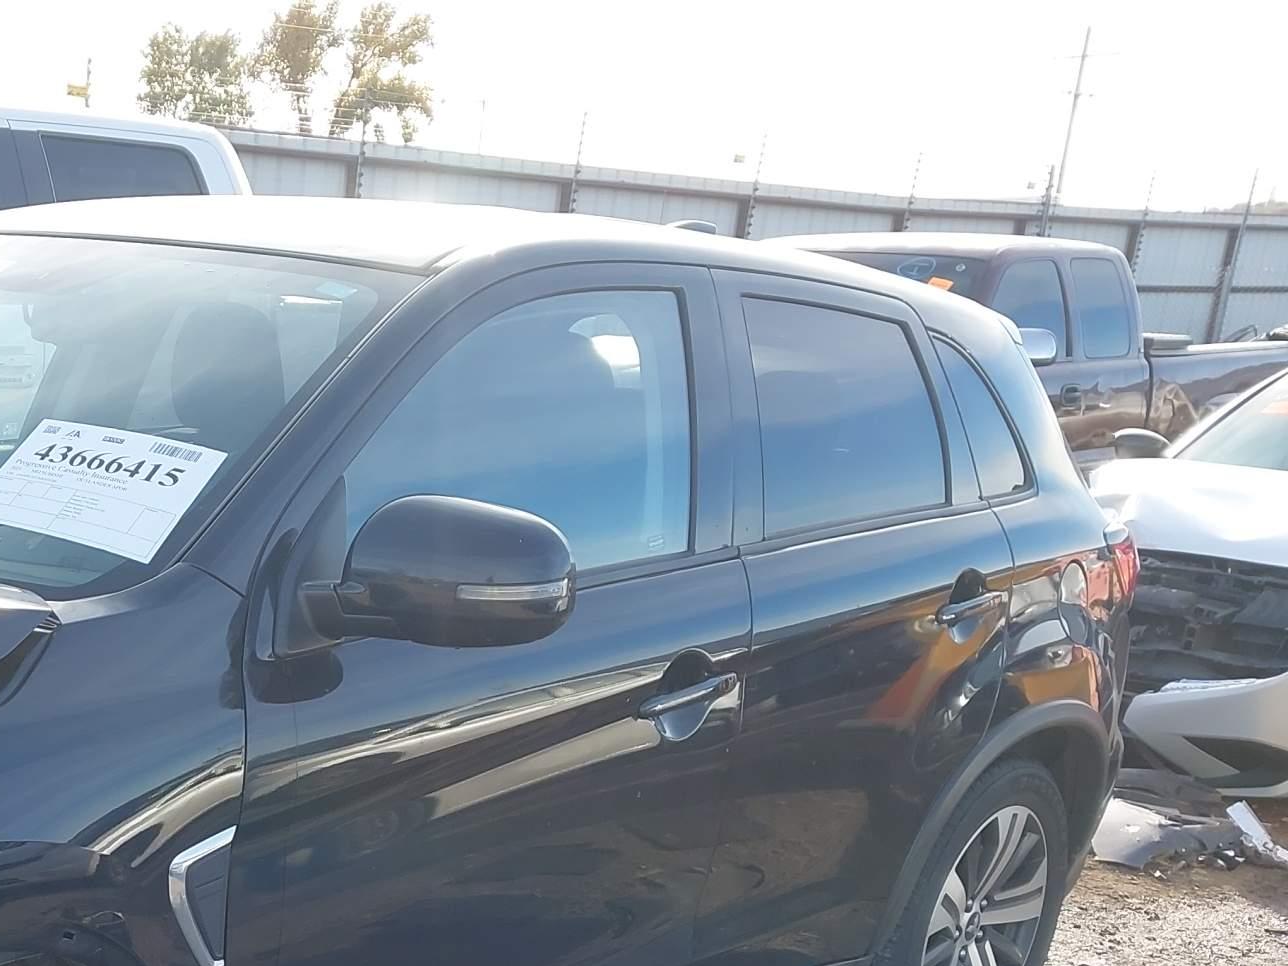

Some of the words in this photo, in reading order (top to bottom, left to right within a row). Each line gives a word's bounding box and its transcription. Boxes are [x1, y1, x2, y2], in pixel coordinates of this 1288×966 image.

[33, 443, 186, 487] 43666415
[58, 464, 89, 478] Casualty
[91, 470, 128, 485] Insurance
